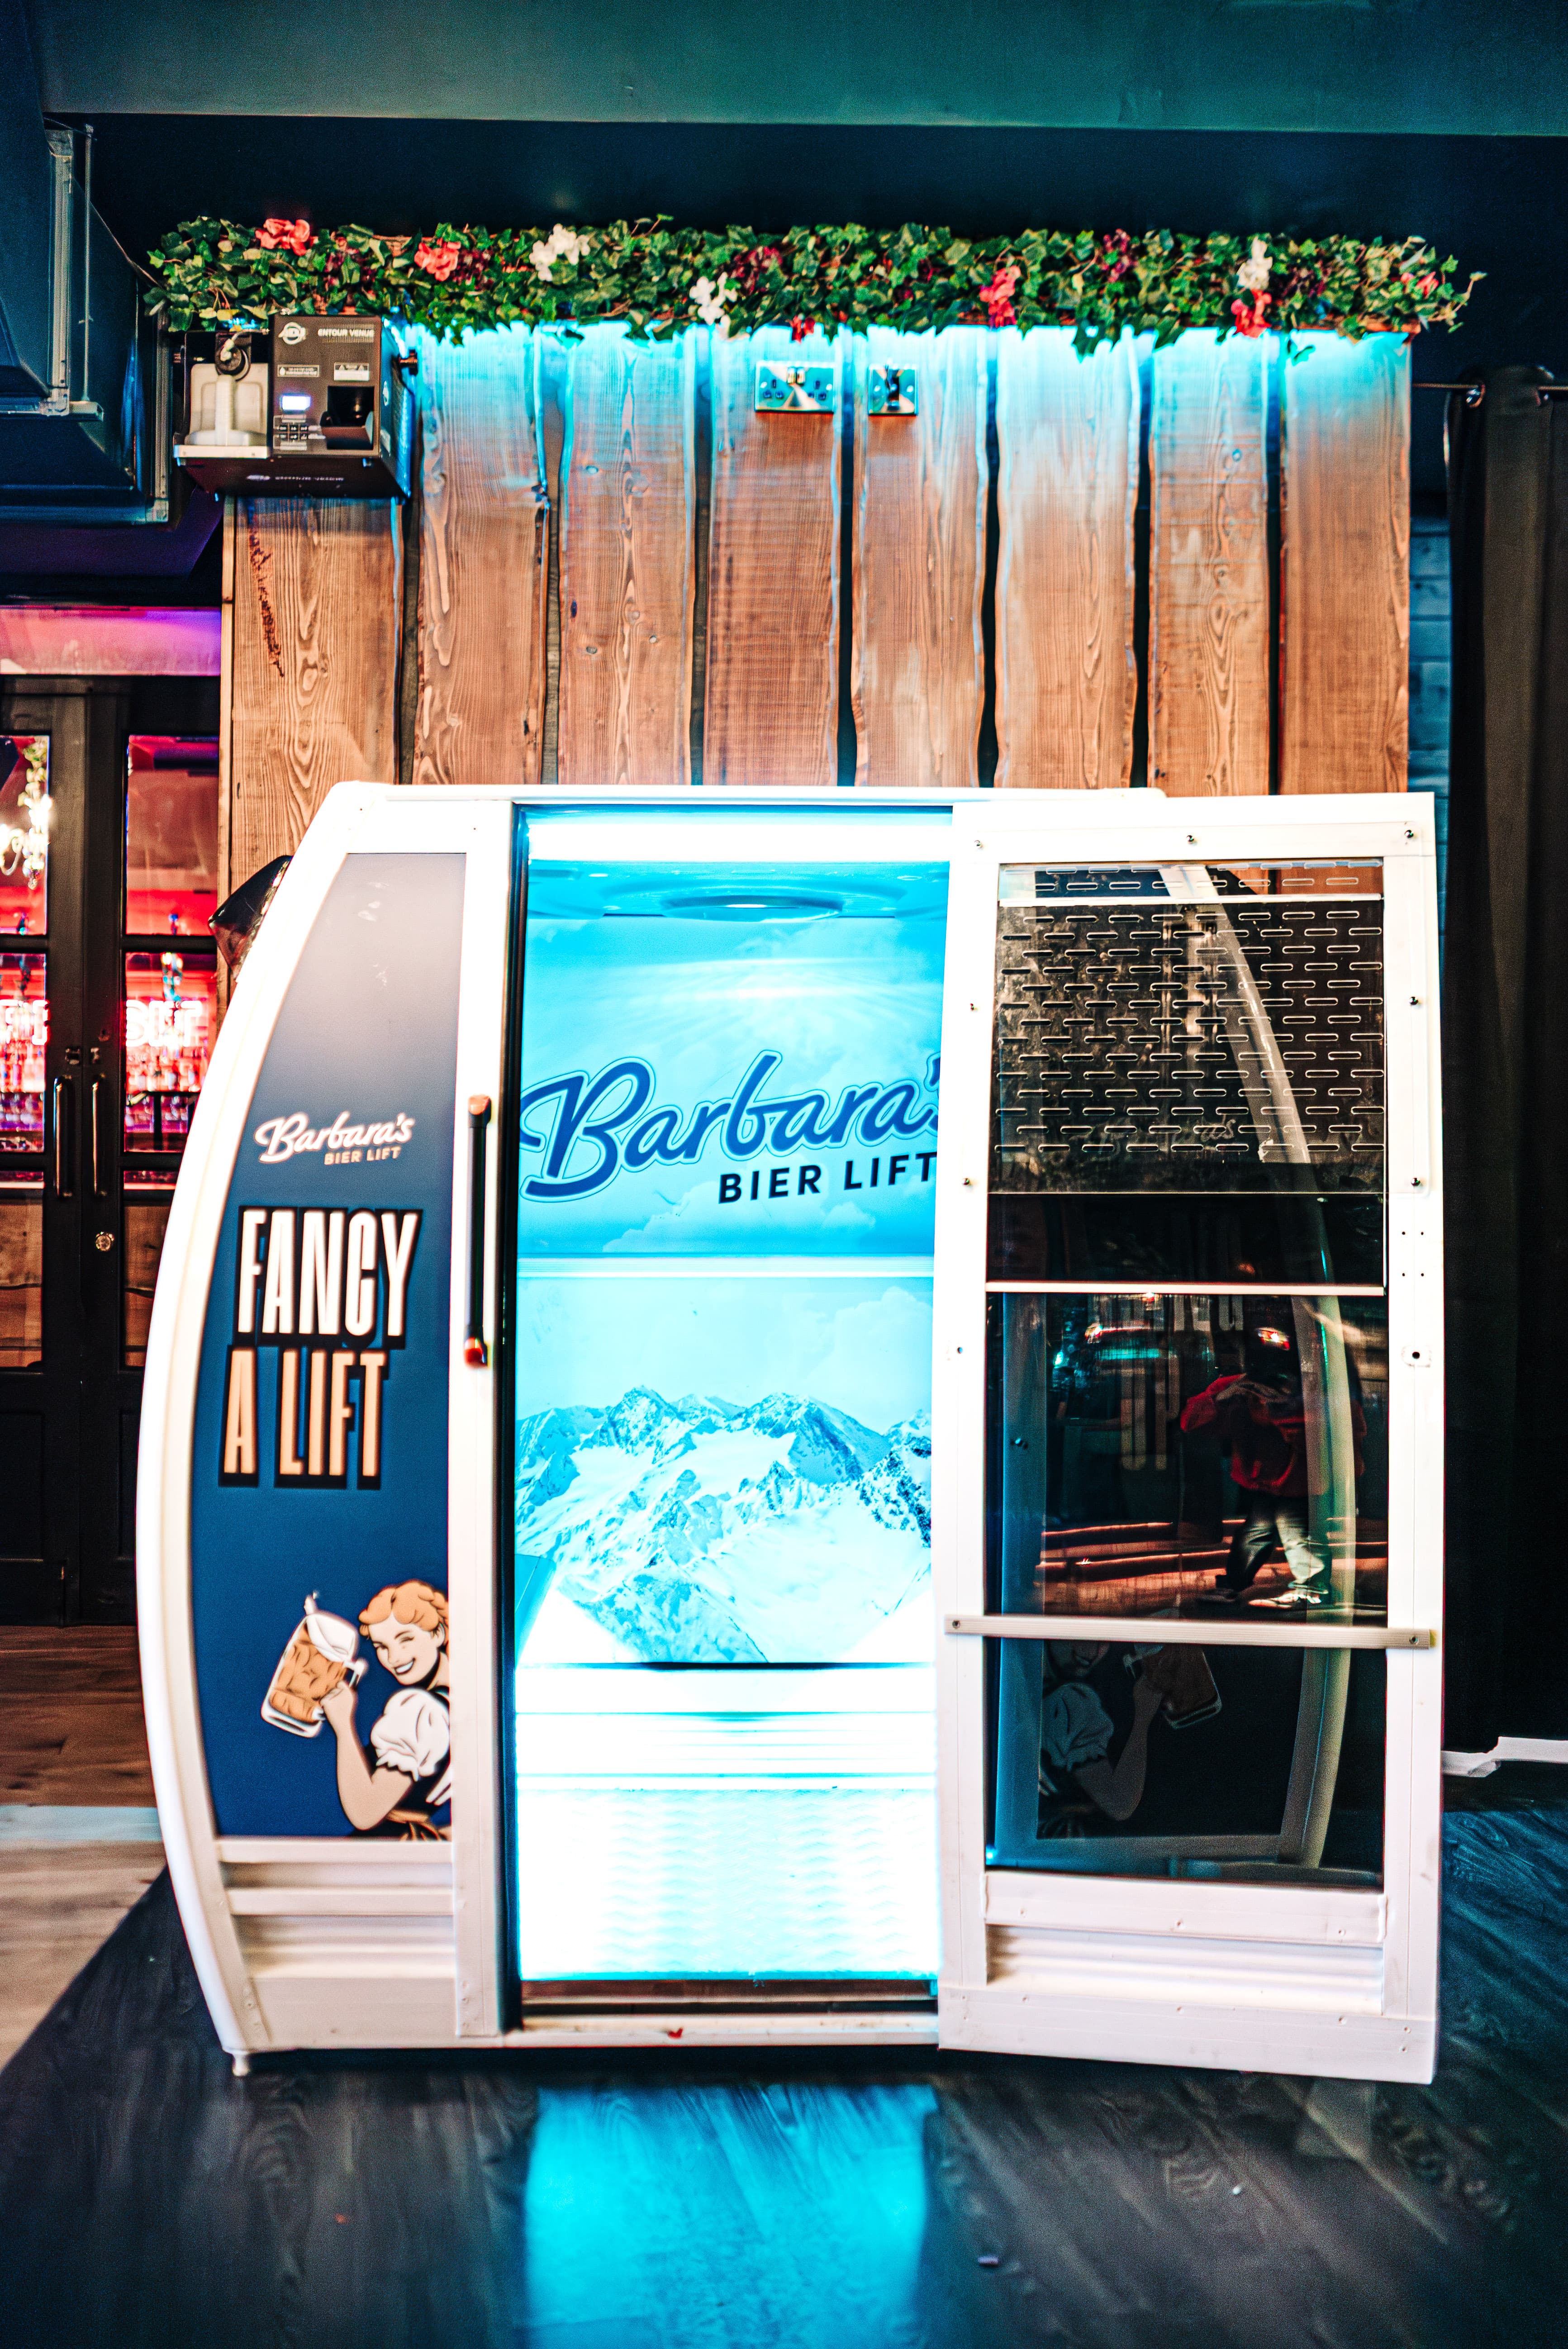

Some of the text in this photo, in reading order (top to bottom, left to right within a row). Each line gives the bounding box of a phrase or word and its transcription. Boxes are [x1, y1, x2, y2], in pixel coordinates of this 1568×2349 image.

[254, 1111, 415, 1163] Barbara's
[324, 1146, 401, 1165] BIER LIFT
[519, 1053, 941, 1198] Barbara'
[718, 1151, 938, 1204] BIER LIFT
[237, 1209, 418, 1337] FANCY
[223, 1349, 387, 1477] A LIFT
